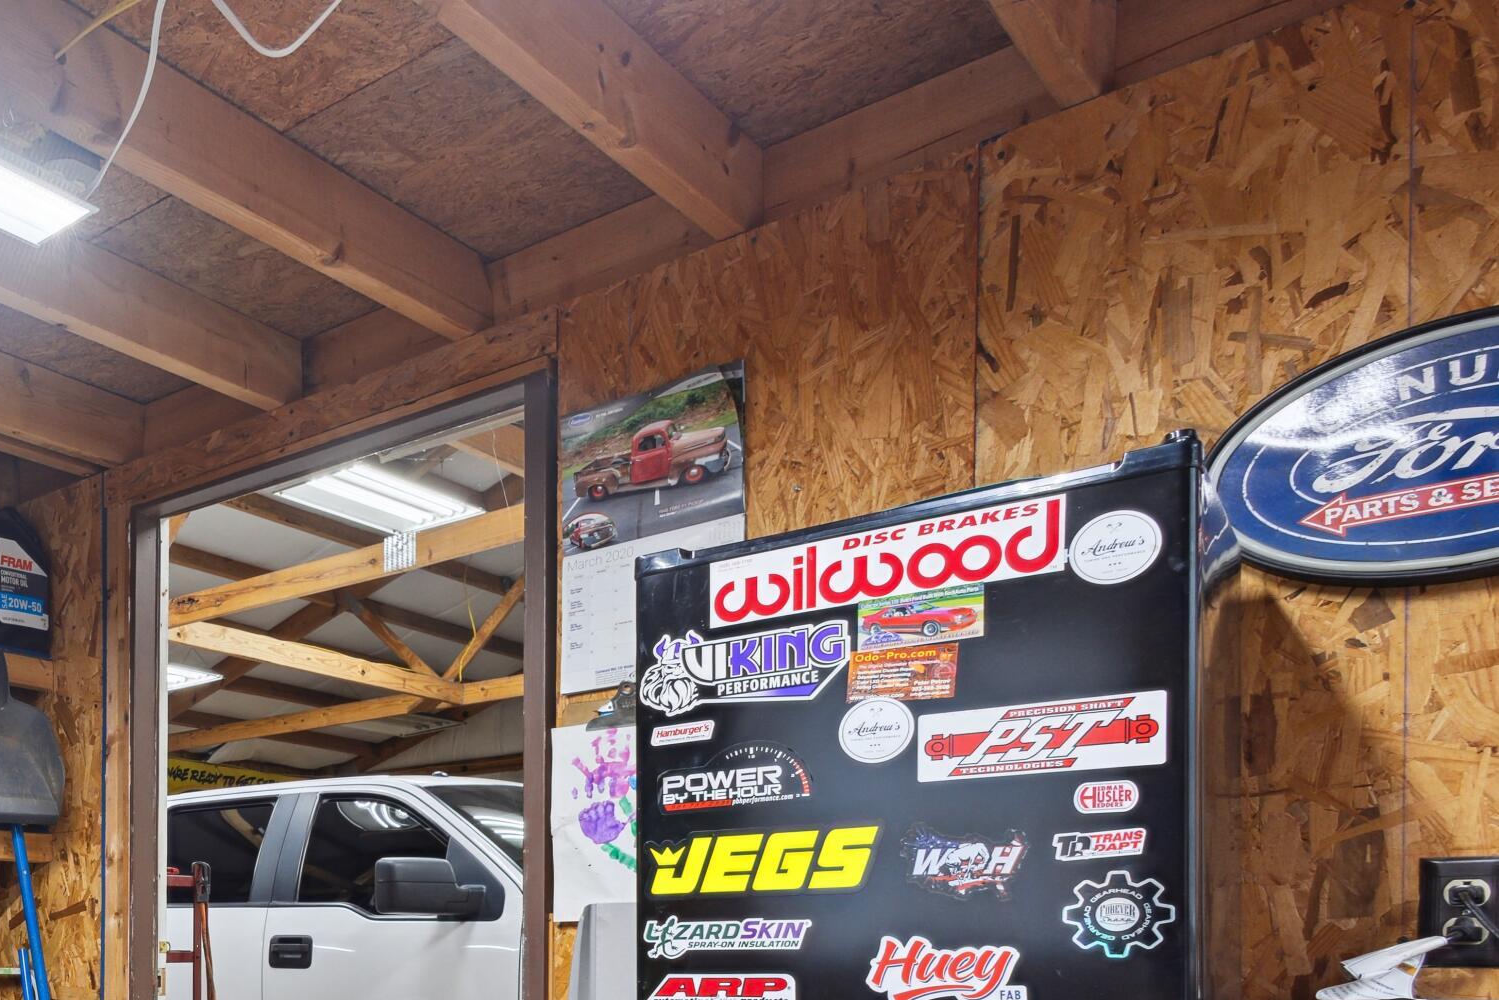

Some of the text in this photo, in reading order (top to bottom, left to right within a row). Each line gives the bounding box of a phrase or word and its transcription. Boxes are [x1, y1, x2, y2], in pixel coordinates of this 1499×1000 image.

[1398, 354, 1499, 400] NU
[1324, 491, 1419, 526] PARTS
[1428, 487, 1454, 507] &
[842, 502, 1038, 551] DISC BRAKES
[1081, 535, 1145, 557] Andrew's
[0, 555, 33, 571] FRAM
[567, 546, 634, 572] March 2020
[715, 499, 1060, 622] wilwood
[0, 575, 28, 588] MOTOR OIL
[8, 597, 42, 613] 20W-50
[682, 623, 845, 683] VIKING
[854, 649, 937, 663] Odo-Pro.com
[717, 670, 819, 697] PERFORMANCE
[1009, 699, 1125, 718] PRECISION SHAFT
[656, 723, 709, 738] Hamburger's
[847, 721, 901, 737] Andrew's
[958, 709, 1123, 766] PST
[960, 759, 1065, 774] TECHNOLOGIES
[190, 769, 221, 785] READY
[222, 775, 236, 787] TO
[662, 765, 783, 795] POWER
[662, 783, 783, 805] BY THE HOUR
[732, 793, 794, 806] pbhperformance.com
[1091, 829, 1144, 842] TRANS
[1094, 840, 1141, 852] DAPT
[651, 826, 879, 895] JEGS
[1090, 888, 1144, 903] GEARHEAD
[1100, 905, 1136, 917] FOREVER
[1122, 902, 1153, 941] GEARHEAD
[1083, 905, 1116, 941] GEARHEAD
[687, 938, 799, 949] SPRAY-ON INSULATION
[871, 940, 1021, 1000] Huey FAB
[654, 977, 788, 998] ARP
